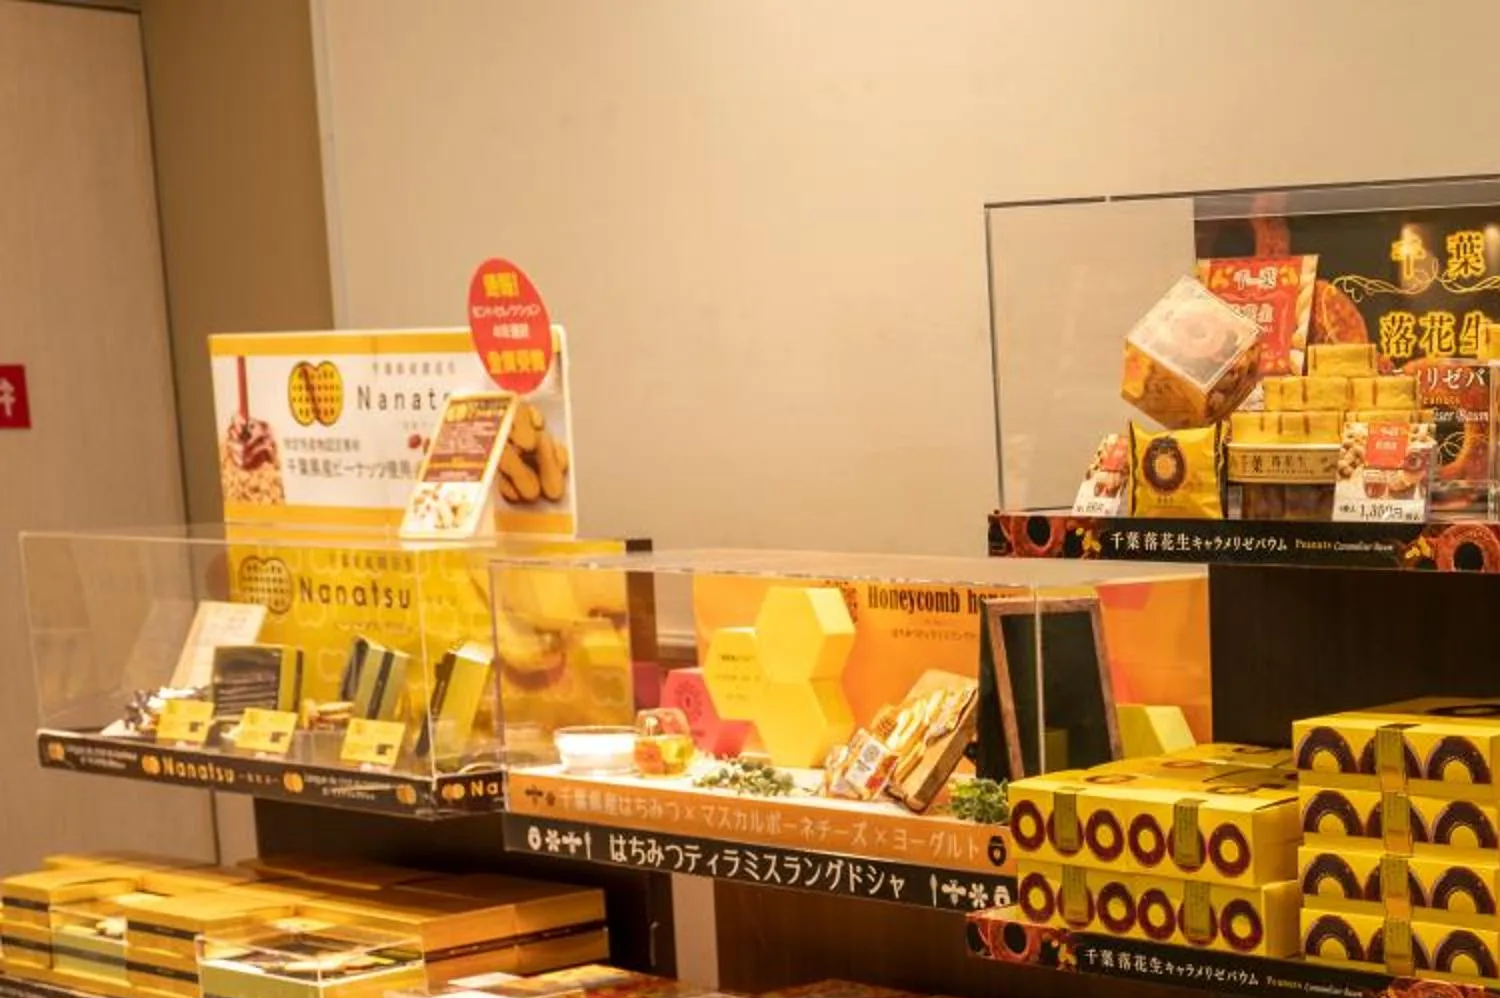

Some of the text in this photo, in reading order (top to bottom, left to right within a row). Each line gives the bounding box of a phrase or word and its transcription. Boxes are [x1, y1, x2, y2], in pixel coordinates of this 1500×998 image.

[1391, 231, 1486, 278] 千葉
[299, 575, 411, 610] Nanatsu
[163, 757, 235, 784] Nanatsu
[609, 833, 905, 899] はちみつティラミスラングドシャ
